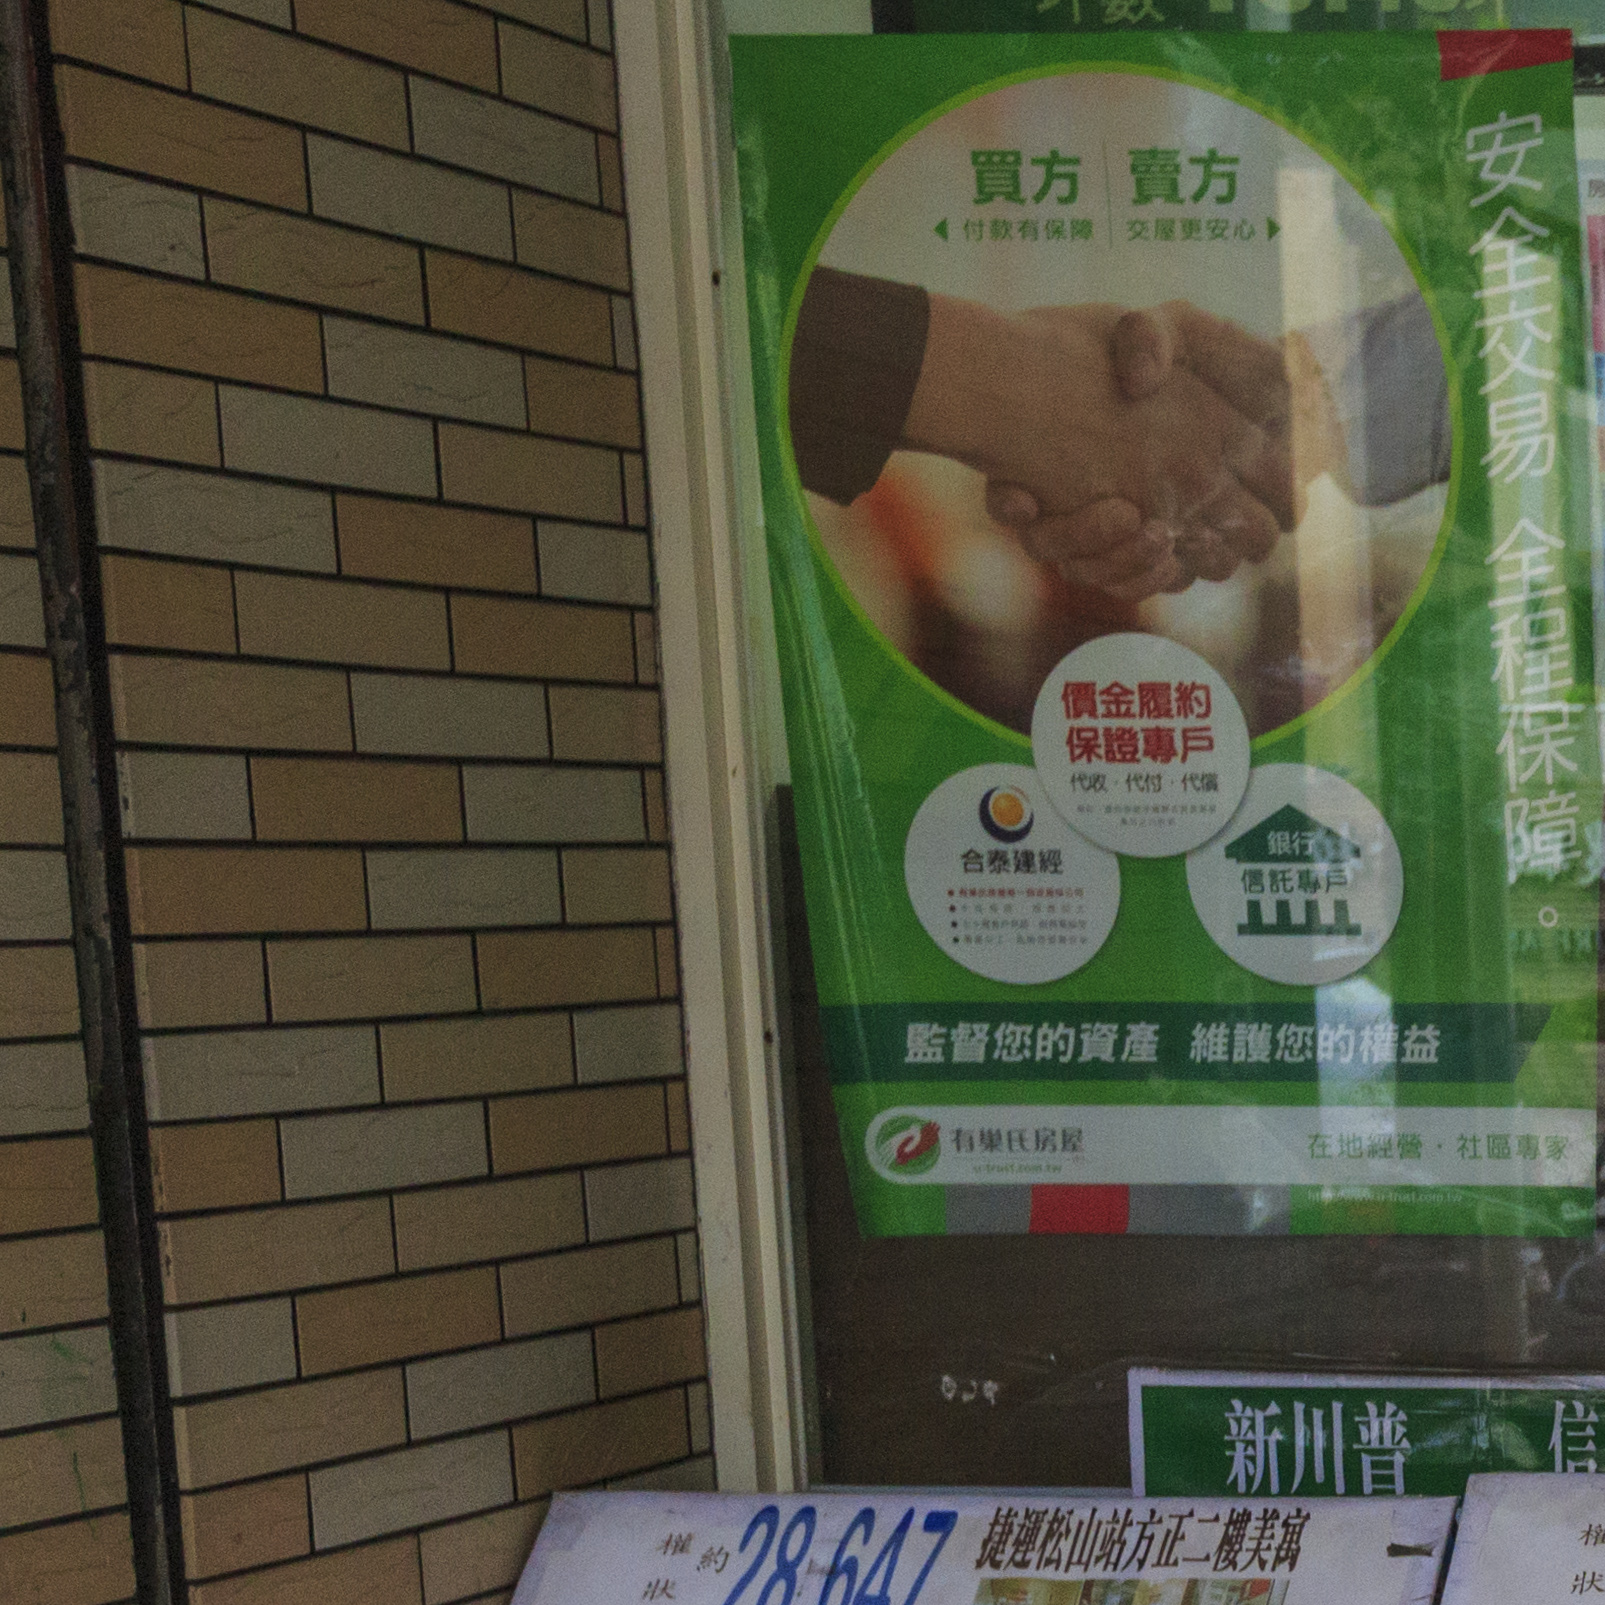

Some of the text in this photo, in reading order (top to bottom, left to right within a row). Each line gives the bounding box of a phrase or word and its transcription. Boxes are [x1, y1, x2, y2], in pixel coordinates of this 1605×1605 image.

[969, 148, 1240, 206] 買方 賣方
[963, 217, 1257, 243] 付款有保障 交屋更安心
[1465, 111, 1557, 484] 安全交易
[1062, 681, 1212, 720] 價金履約
[1066, 726, 1215, 763] 保證專戶
[961, 849, 1064, 874] 合泰建經
[904, 1022, 1441, 1065] 監督您的資產 維護您的權益
[951, 1127, 1085, 1155] 有巢氏房屋
[1224, 1399, 1410, 1496] 新川普
[696, 1544, 729, 1574] 約
